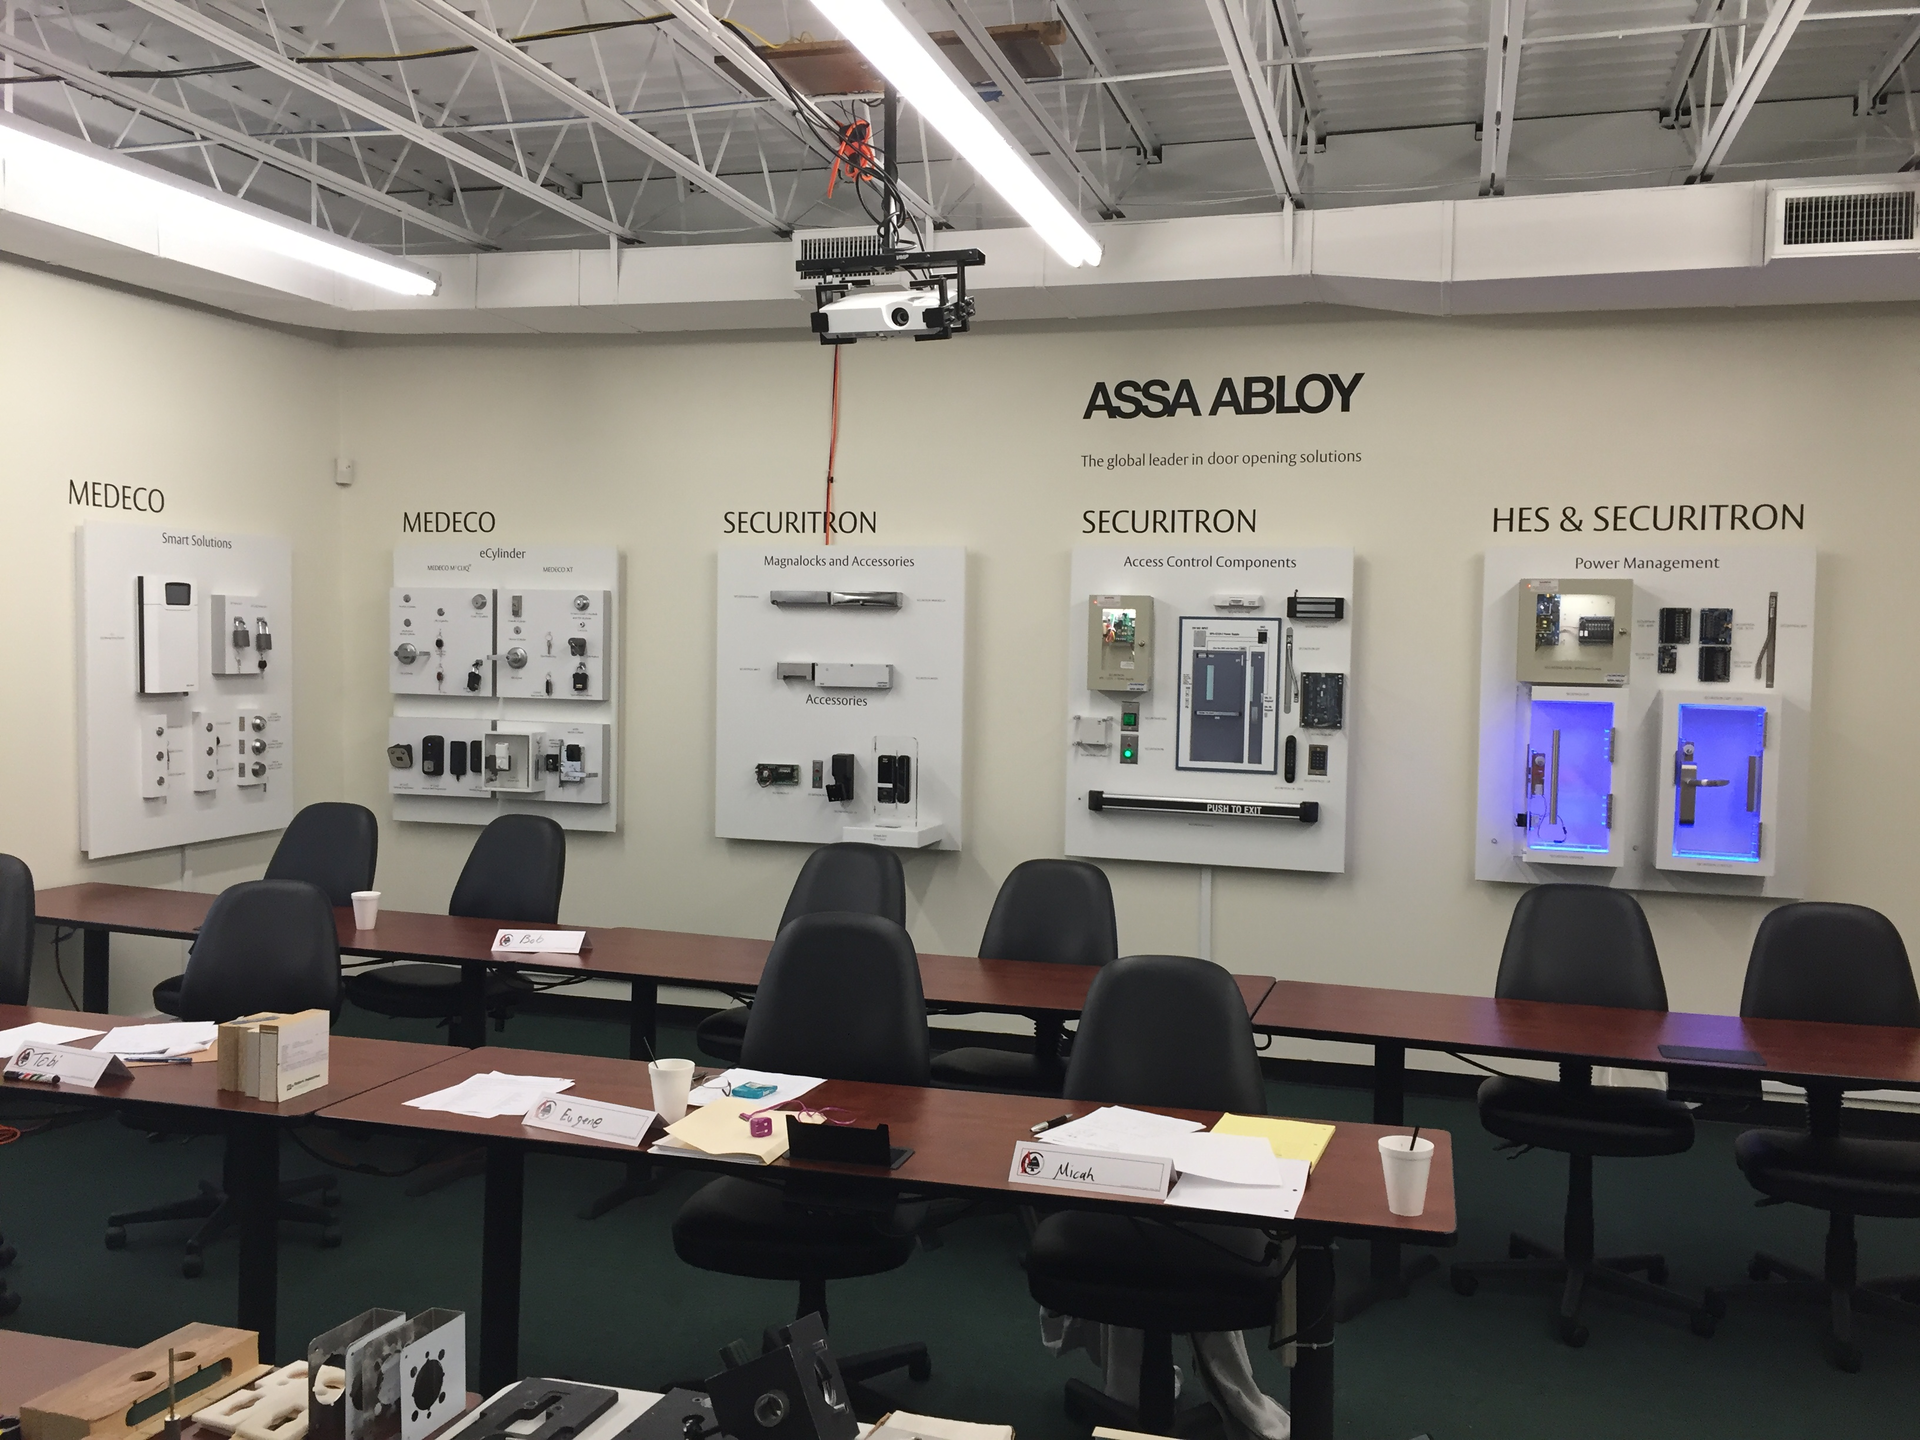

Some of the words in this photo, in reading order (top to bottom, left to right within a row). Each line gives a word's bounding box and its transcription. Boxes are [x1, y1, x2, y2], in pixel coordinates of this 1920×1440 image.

[1083, 378, 1202, 419] ASSA
[1208, 373, 1365, 416] ABLOY
[1081, 454, 1104, 467] The
[1107, 454, 1146, 470] global
[1149, 453, 1189, 467] leader
[1192, 453, 1204, 466] in
[1207, 452, 1239, 465] door
[1242, 451, 1297, 467] opening
[1300, 450, 1362, 464] solutions
[69, 479, 164, 513] MEDECO
[403, 511, 495, 533] MEDECO
[723, 511, 876, 534] SECURITRON
[1082, 509, 1257, 534] SECURITRON
[1493, 506, 1550, 533] HES
[1559, 506, 1583, 532] &
[1593, 504, 1805, 532] SECURITRON
[162, 532, 190, 546] Smart
[191, 535, 233, 549] Solutions
[479, 548, 526, 561] eCylinder
[764, 555, 827, 569] Magnalocks
[829, 555, 849, 567] and
[851, 556, 915, 567] Accessories
[1123, 556, 1164, 568] Access
[1166, 556, 1213, 568] Control
[1215, 556, 1297, 570] Components
[1575, 557, 1620, 570] Power
[1623, 557, 1720, 572] Management
[805, 694, 868, 707] Accessories
[1206, 803, 1230, 813] PUSH
[1231, 805, 1242, 814] TO
[1243, 805, 1262, 815] EXIT
[519, 934, 544, 944] Bob
[33, 1052, 63, 1068] Tobi
[559, 1107, 603, 1129] Eugene
[1052, 1161, 1095, 1181] Micah
